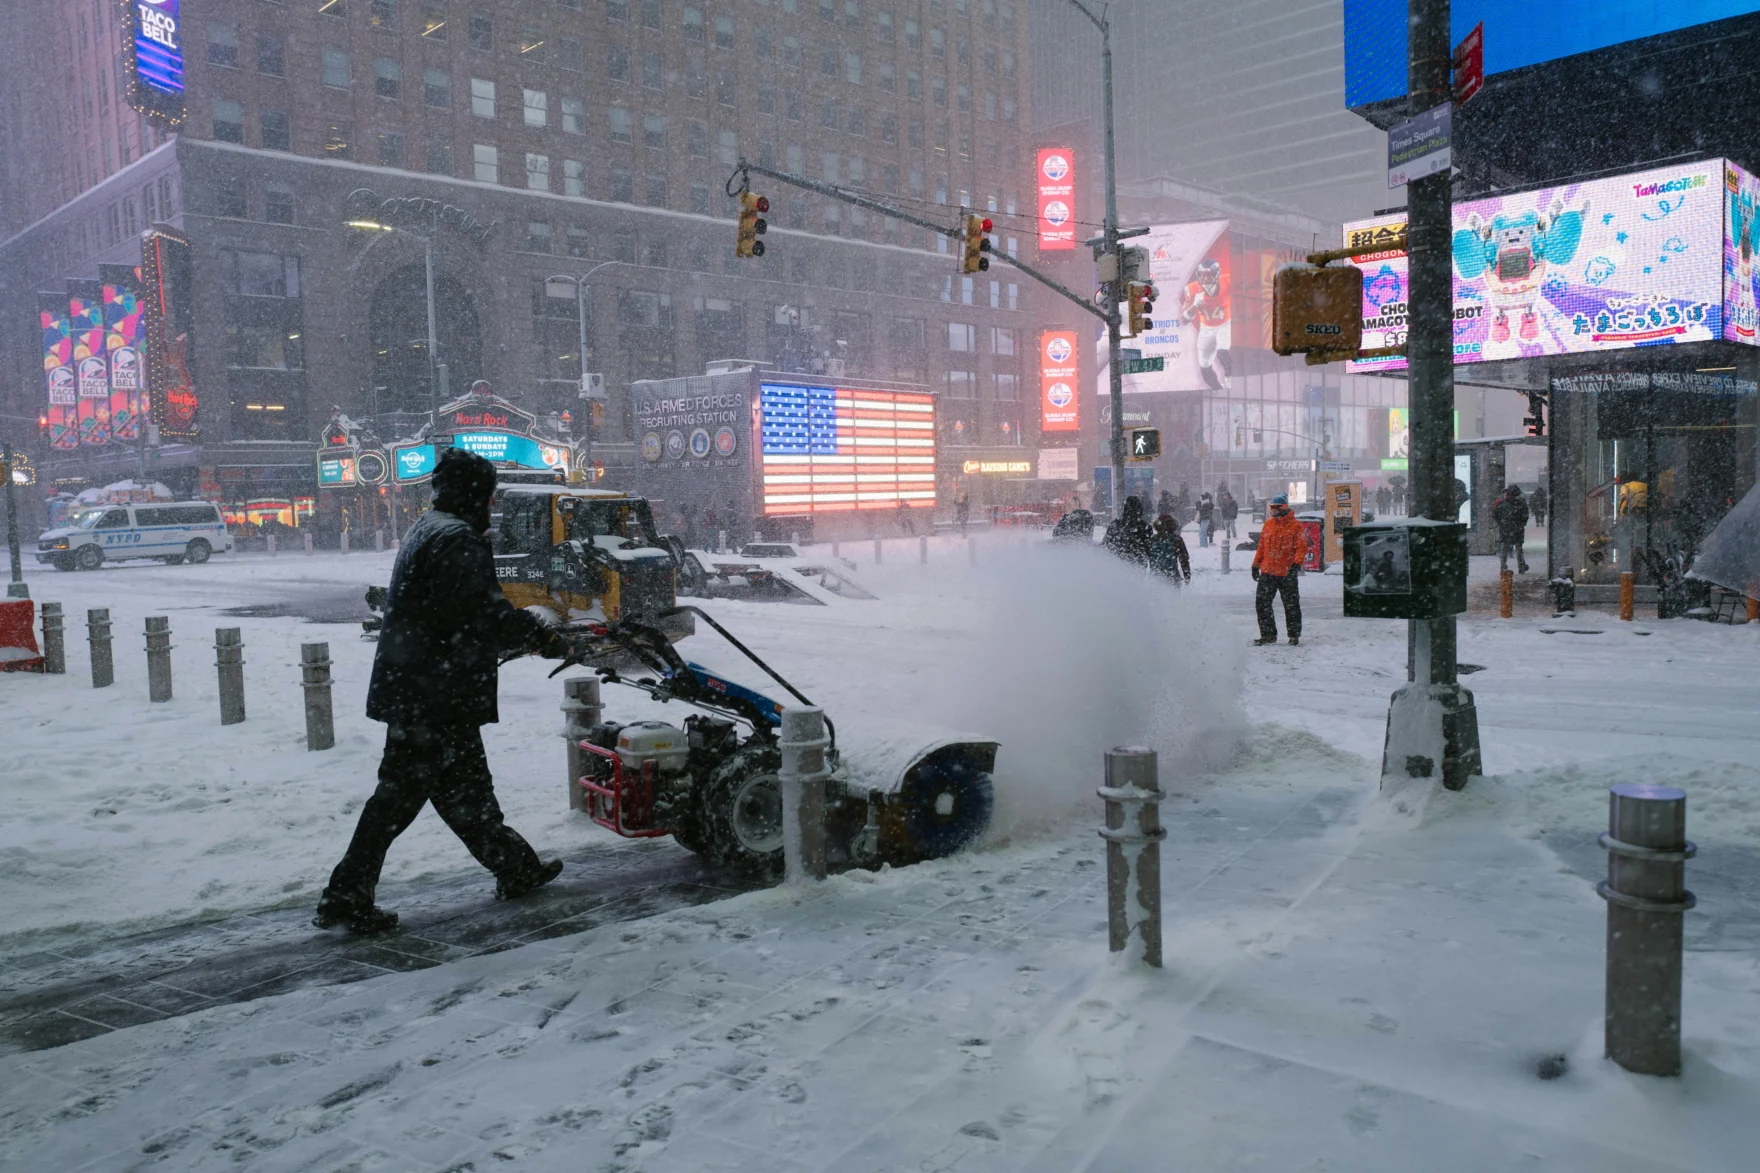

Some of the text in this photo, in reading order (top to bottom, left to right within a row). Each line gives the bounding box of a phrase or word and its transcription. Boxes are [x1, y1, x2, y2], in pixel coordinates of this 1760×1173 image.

[139, 4, 175, 32] TACO
[143, 21, 177, 49] BELL
[1391, 137, 1412, 151] Times
[1413, 126, 1440, 142] Square
[1391, 136, 1448, 163] Pedestrian Plaza
[1360, 249, 1406, 261] CHOGOK
[1381, 303, 1409, 315] CHO
[1152, 319, 1180, 329] ATRIOTS
[1362, 306, 1483, 330] AMAGOT BOT
[1573, 303, 1708, 335] たまごっちろぼ
[1305, 324, 1341, 335] SKED
[1145, 335, 1179, 345] BRONCOS
[1453, 343, 1481, 354] ore
[1145, 351, 1181, 359] SUNDAY
[1131, 360, 1139, 372] W
[81, 381, 107, 389] TACO
[654, 398, 693, 413] ARMED
[695, 393, 742, 410] FORCES
[641, 410, 737, 428] RECRUITING STATION
[1100, 402, 1151, 424] Pamount
[456, 412, 508, 428] Hard Rock
[980, 462, 1008, 472] RAISING
[1008, 462, 1030, 472] CANE'S
[106, 533, 141, 544] NYPD
[495, 567, 518, 578] EERE
